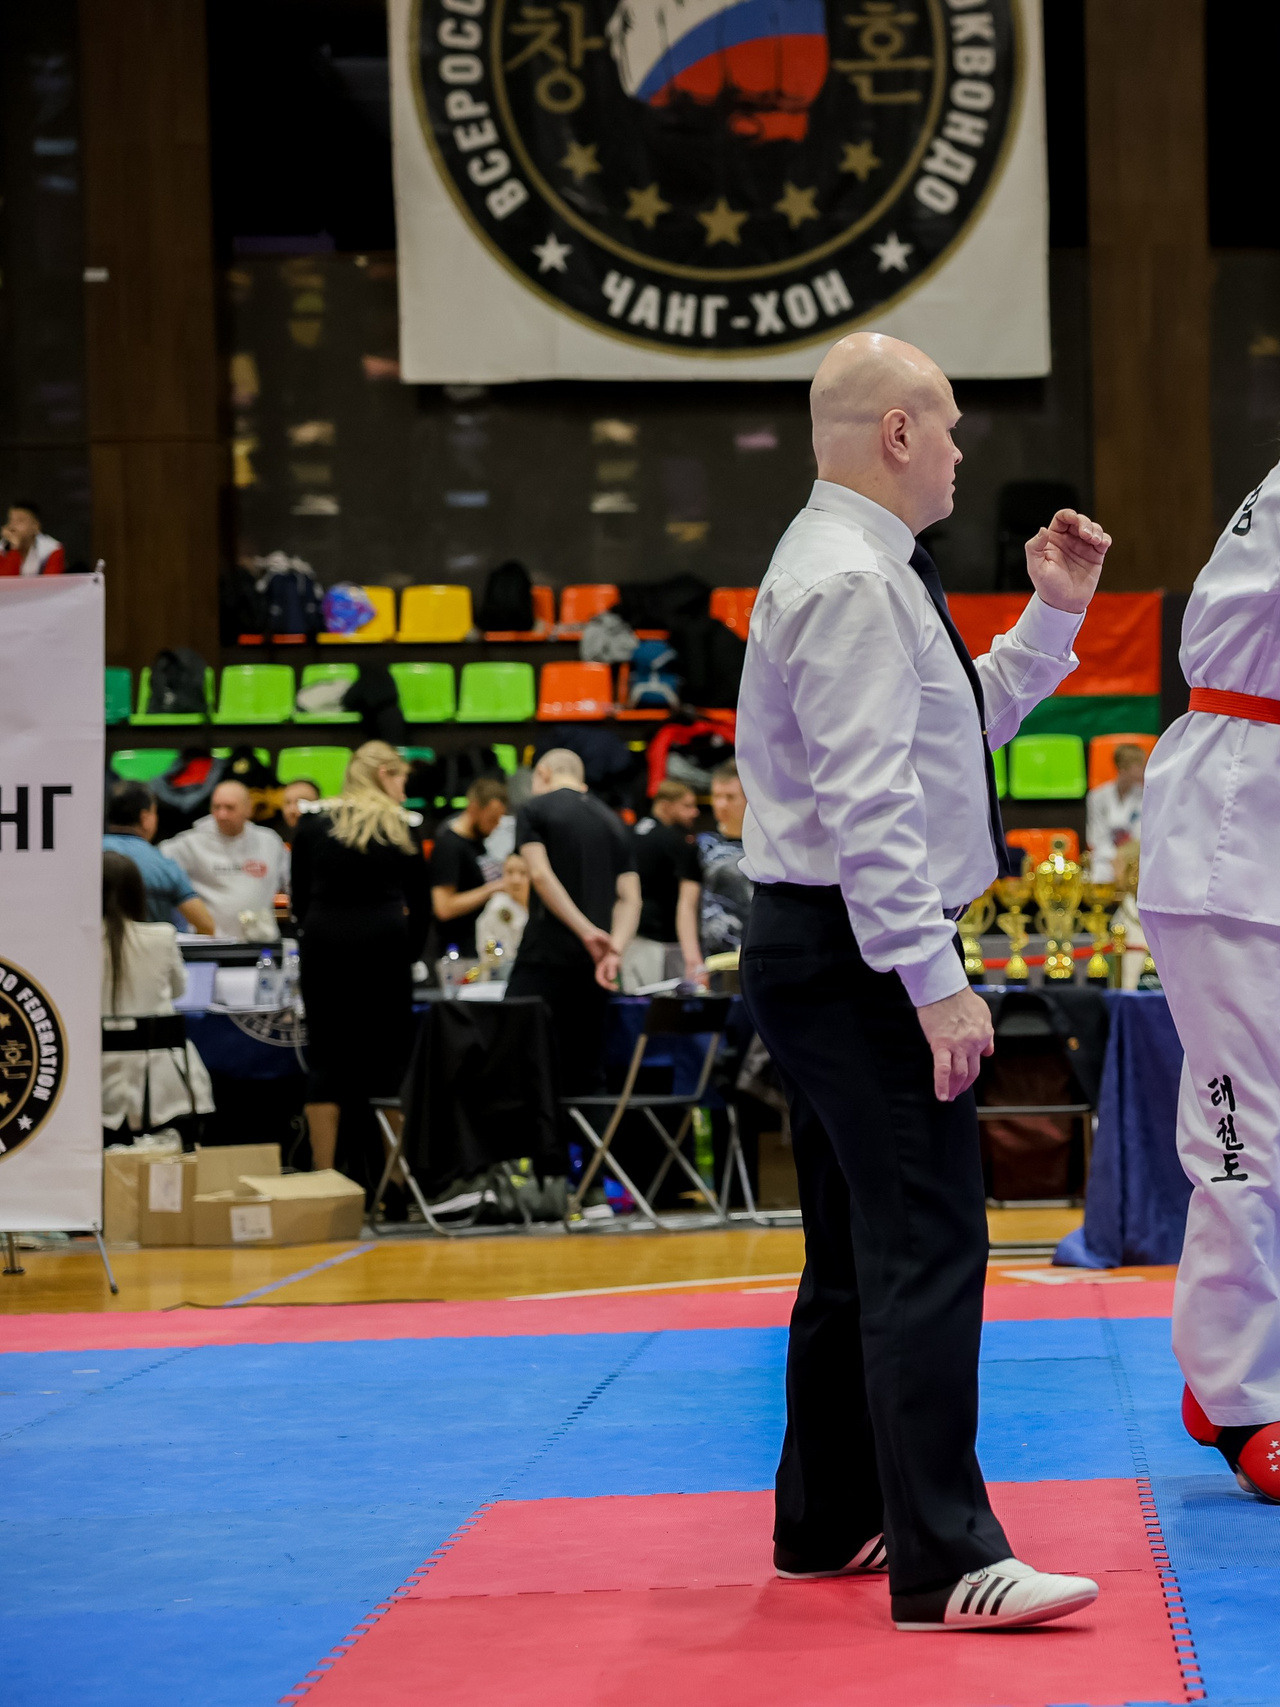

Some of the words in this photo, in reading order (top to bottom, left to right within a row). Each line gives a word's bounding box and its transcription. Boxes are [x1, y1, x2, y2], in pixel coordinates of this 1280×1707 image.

[914, 0, 996, 215] КВОНДО
[600, 269, 855, 337] ЧАНГ-ХОН
[16, 986, 58, 1101] FEDERATION
